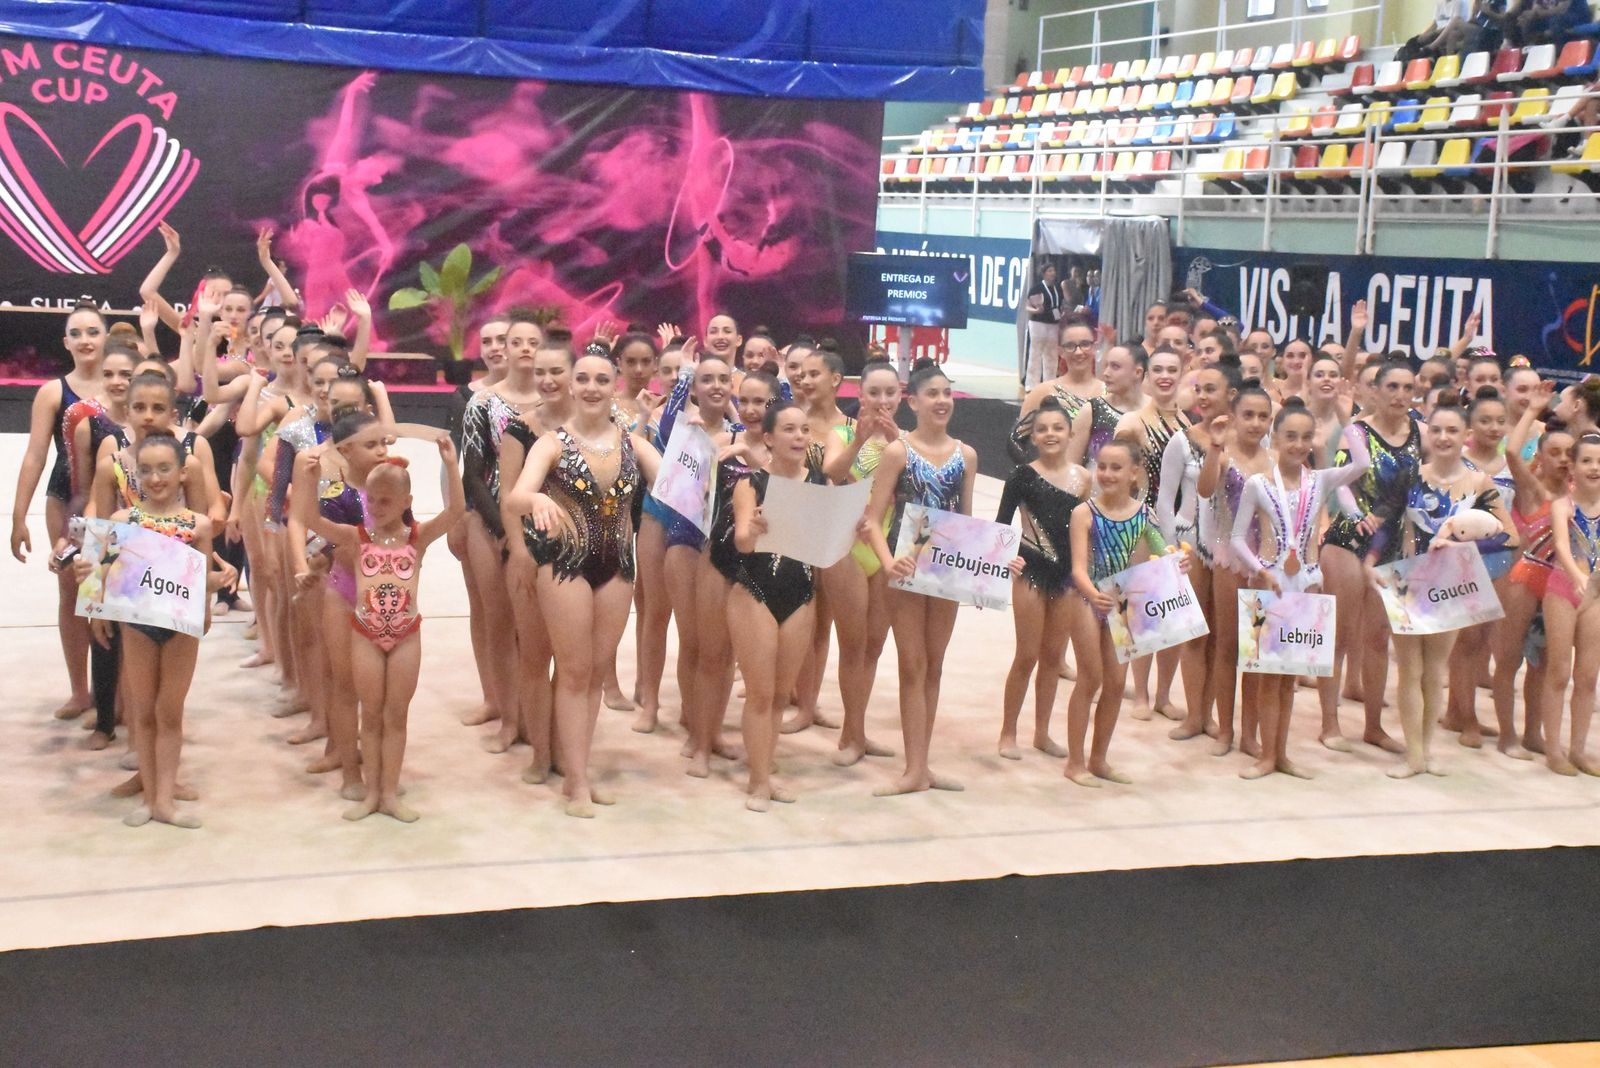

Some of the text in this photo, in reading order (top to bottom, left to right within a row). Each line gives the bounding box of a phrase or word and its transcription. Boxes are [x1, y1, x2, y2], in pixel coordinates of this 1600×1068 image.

[0, 42, 178, 121] M CEUTA
[31, 77, 109, 104] CUP
[881, 272, 936, 285] ENTREGA DE
[981, 256, 1005, 307] DE
[31, 295, 112, 310] SUEA
[887, 289, 928, 300] PREMIOS
[1365, 272, 1493, 361] CEUTA
[931, 546, 1010, 580] Trebujena
[140, 566, 190, 600] Ágora
[1145, 588, 1192, 619] Gymdal
[1279, 627, 1324, 649] Lebrija
